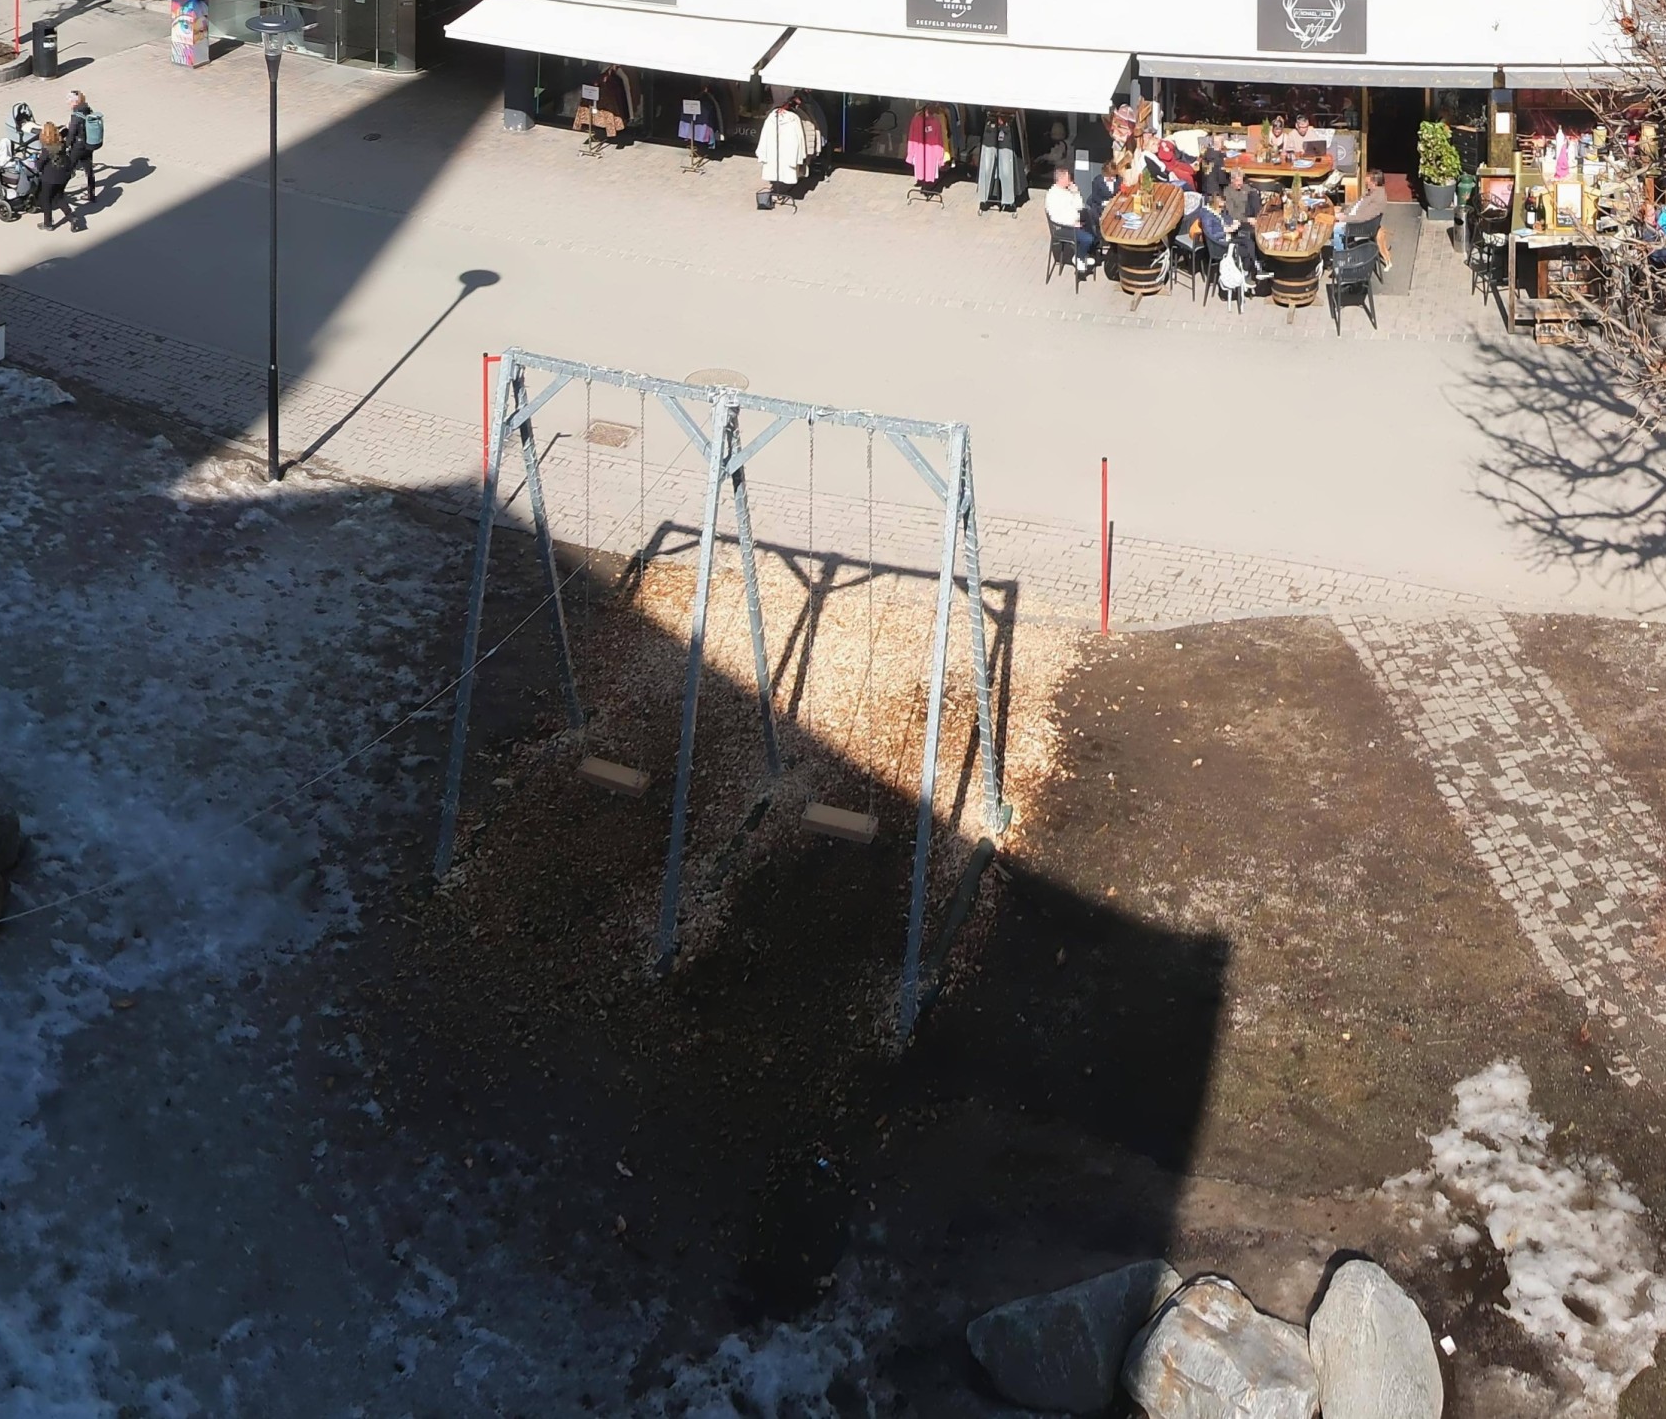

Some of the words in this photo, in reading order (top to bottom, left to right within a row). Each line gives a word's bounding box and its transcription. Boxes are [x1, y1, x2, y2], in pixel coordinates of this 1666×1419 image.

[943, 3, 972, 11] SEEFELD
[916, 19, 945, 27] SEEFELD
[947, 21, 982, 30] SHOPPING
